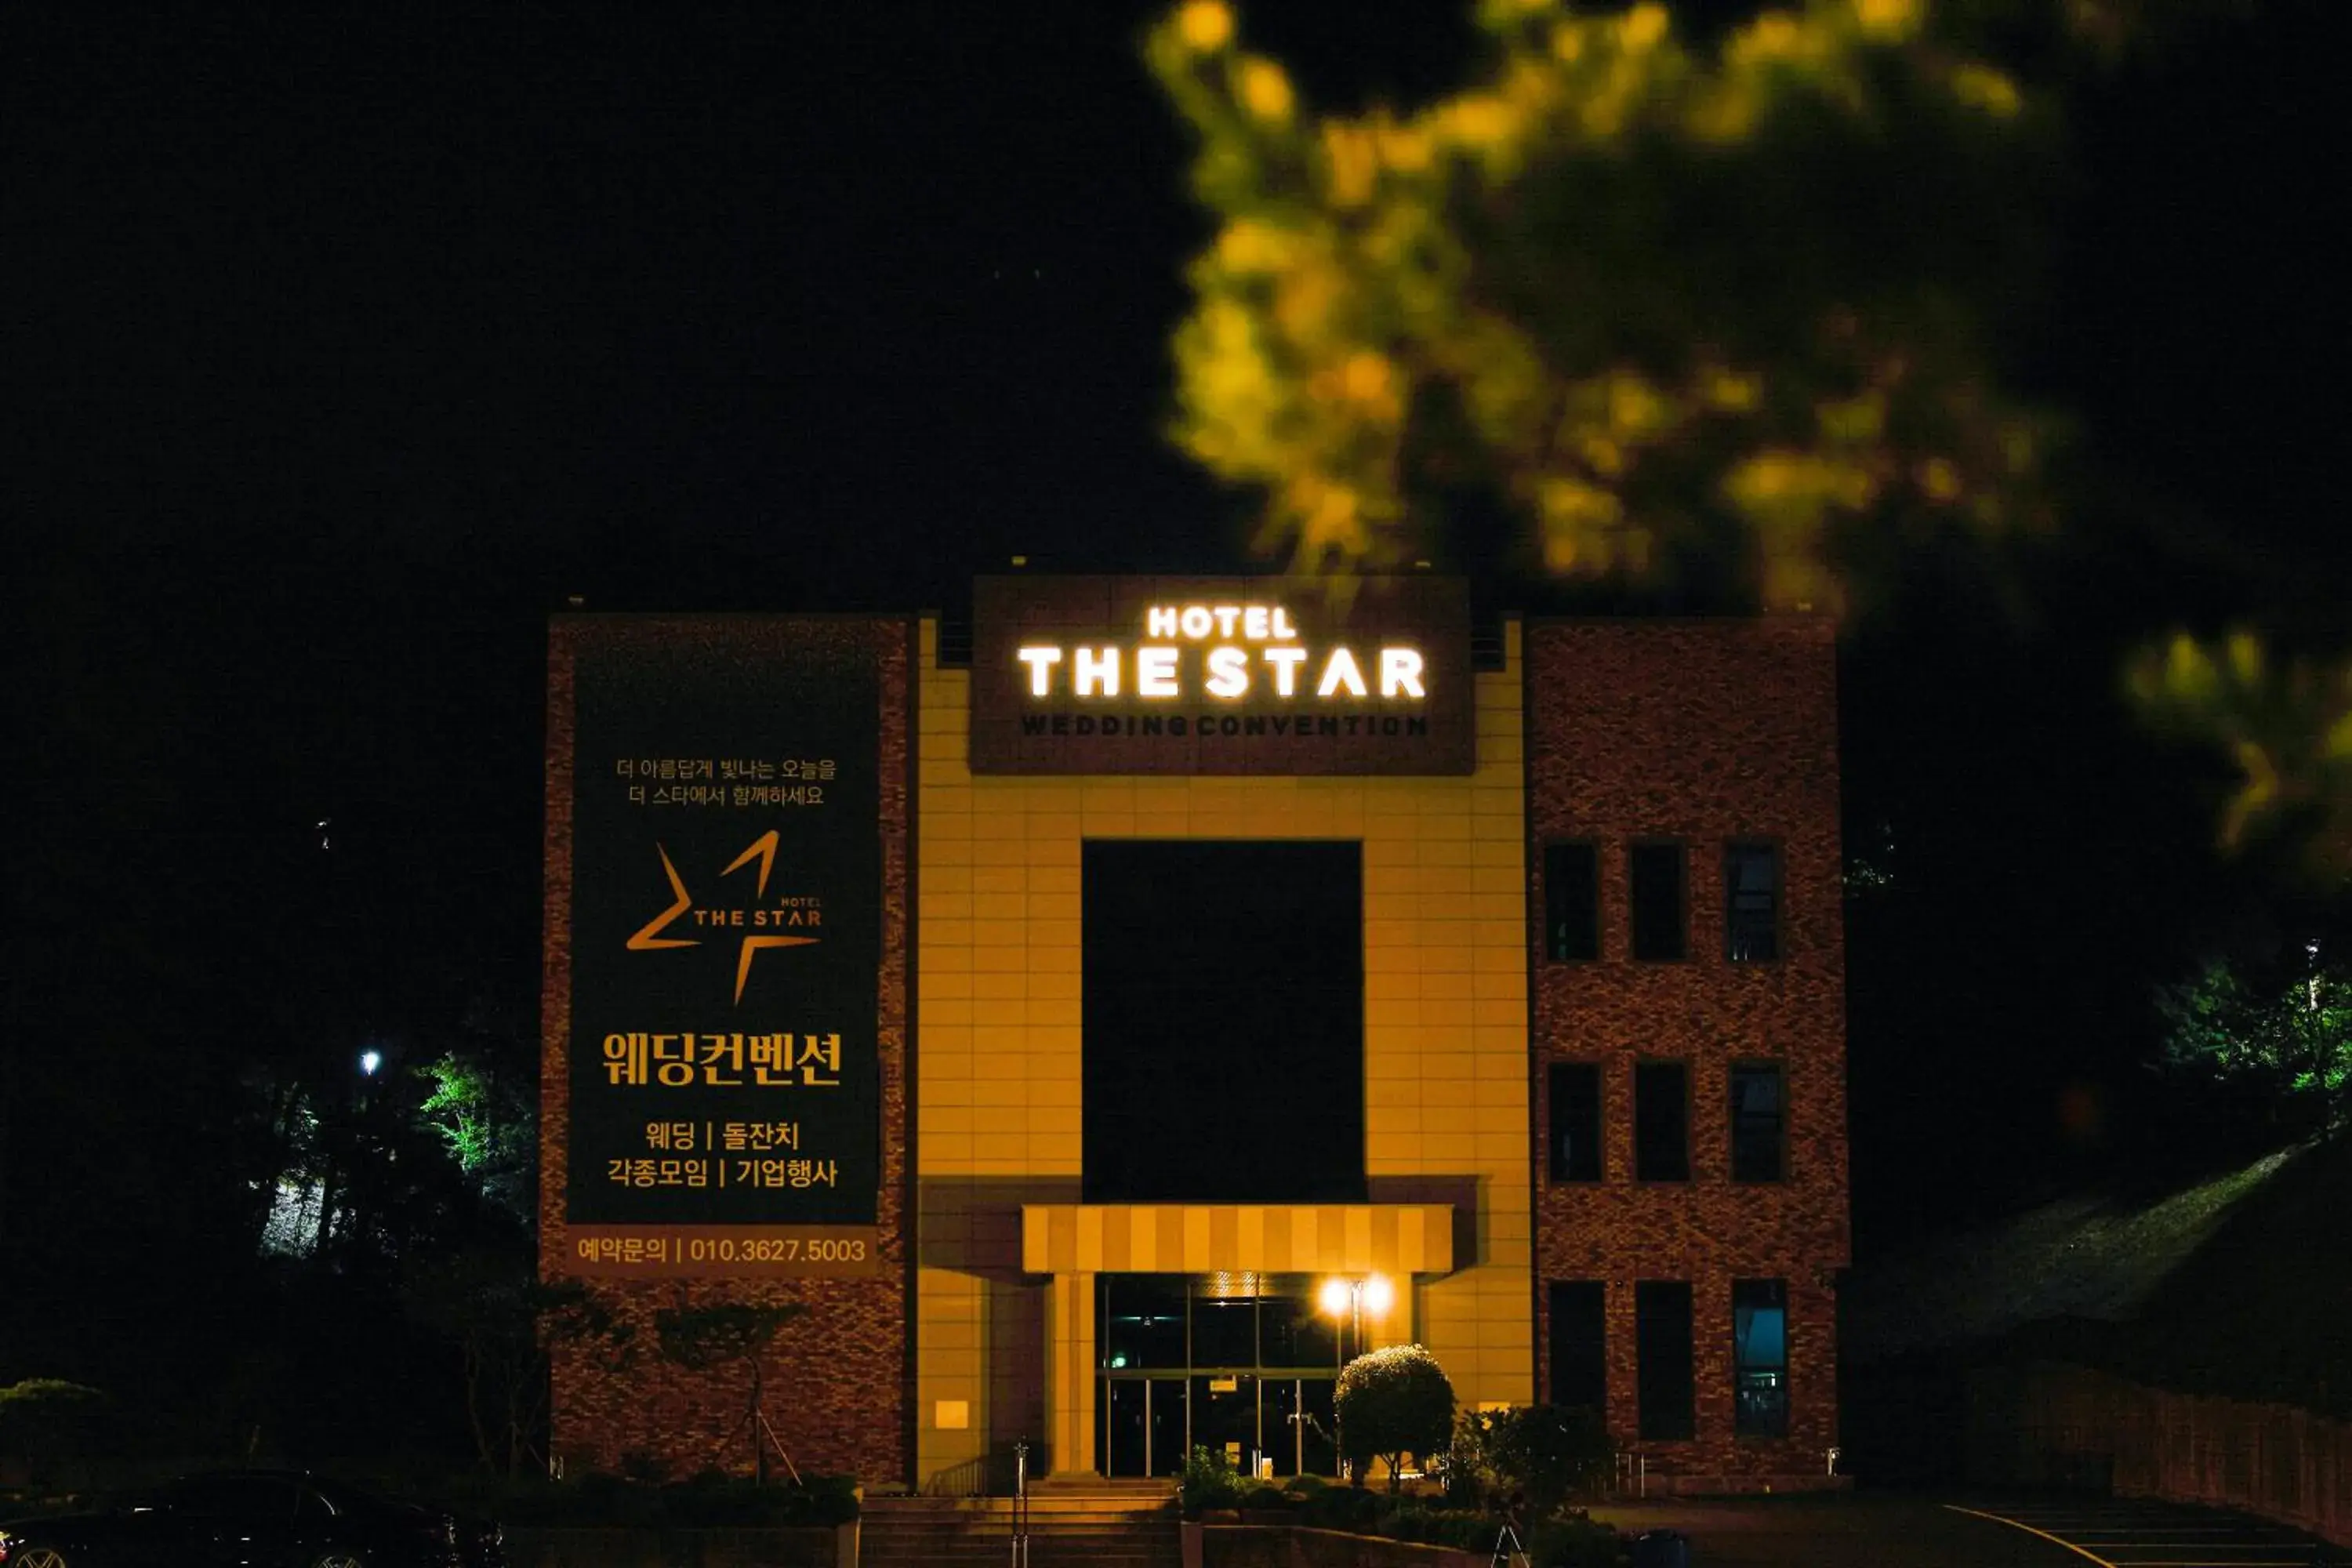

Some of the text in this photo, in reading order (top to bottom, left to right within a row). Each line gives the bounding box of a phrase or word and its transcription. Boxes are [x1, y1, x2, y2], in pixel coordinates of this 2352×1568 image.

[1147, 606, 1298, 638] HOTEL
[1018, 647, 1427, 699] THE STAR
[1023, 716, 1428, 737] WEDDING CONVENTION
[617, 758, 837, 781] 더 아름답게 빛나는 오늘을
[629, 786, 824, 807] 더 스타에서 함께하세요
[781, 898, 822, 907] HOTEL
[694, 909, 822, 926] THE STAR
[602, 1033, 842, 1086] 웨딩컨벤션
[645, 1121, 800, 1150] 웨딩 돌잔치
[608, 1160, 838, 1188] 각종모임 기업행사
[578, 1238, 866, 1263] 예약문의 010.3627.5003
